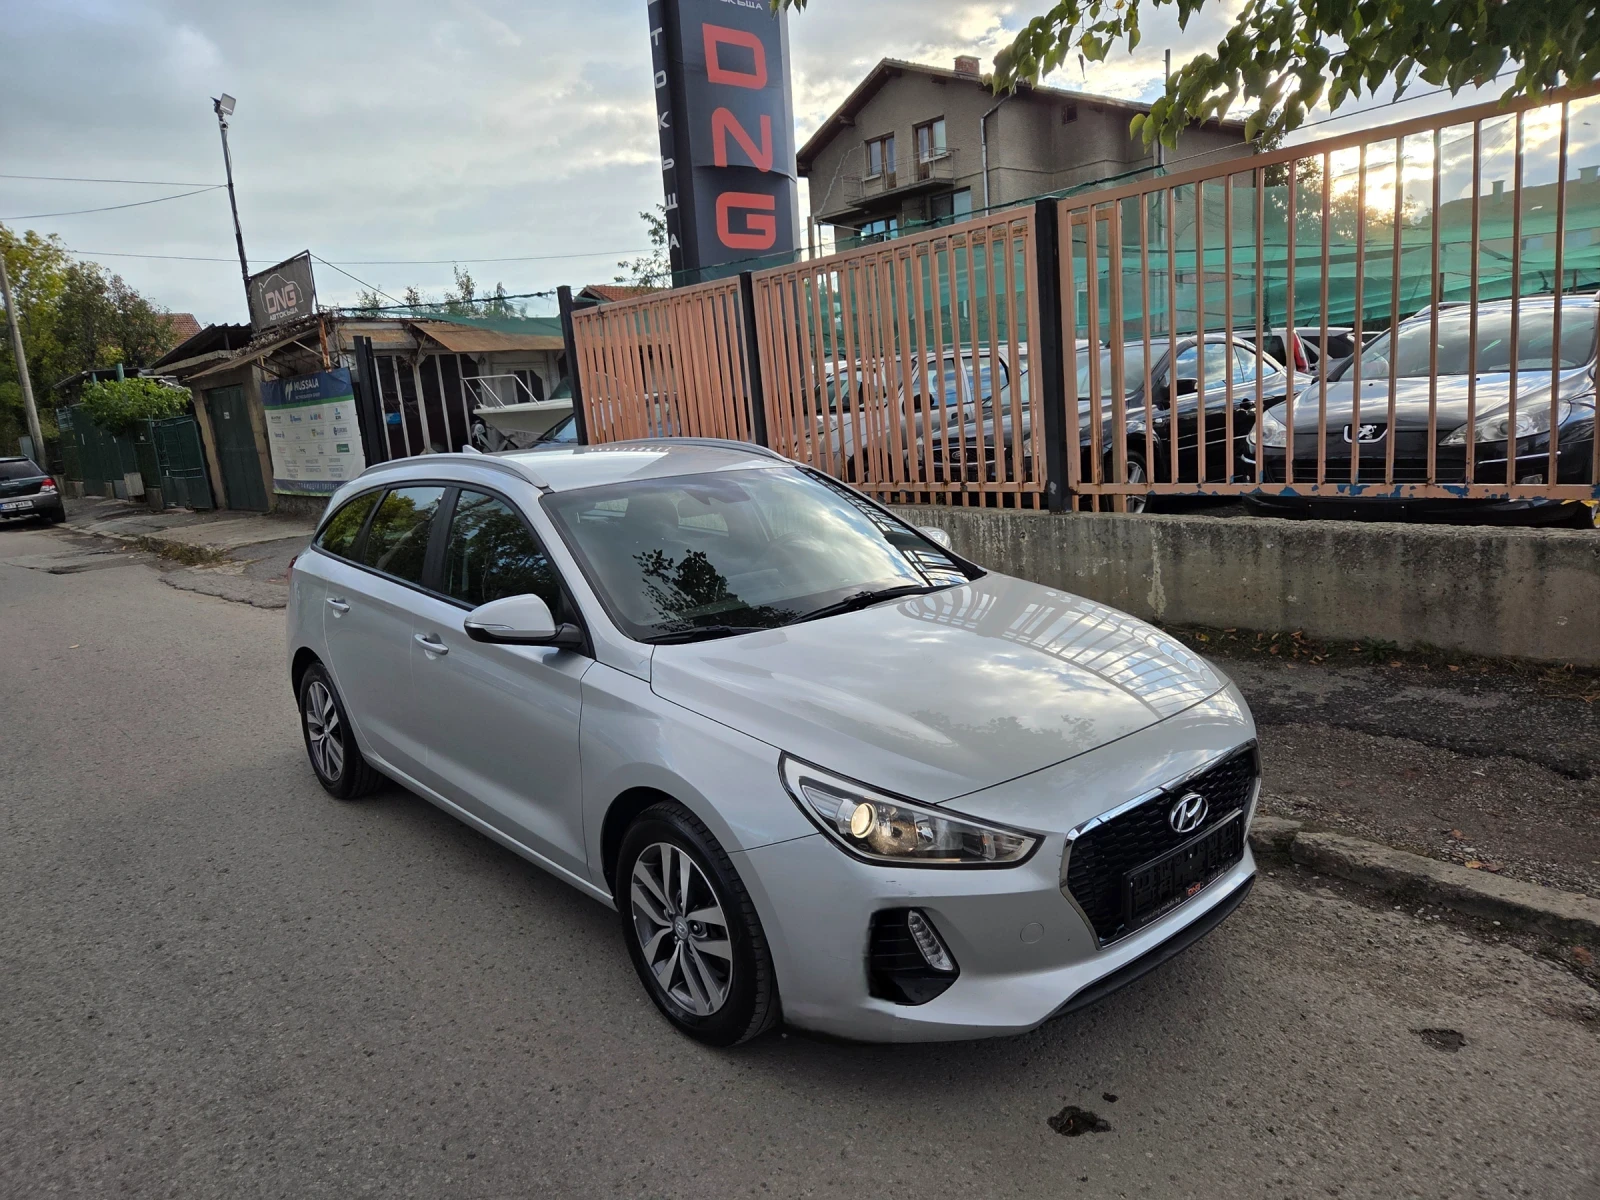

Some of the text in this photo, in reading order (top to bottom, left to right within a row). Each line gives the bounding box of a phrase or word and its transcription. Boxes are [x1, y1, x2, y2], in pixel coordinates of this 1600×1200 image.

[702, 22, 776, 250] DNG
[265, 284, 297, 314] DNG
[293, 378, 320, 391] MUSSALA
